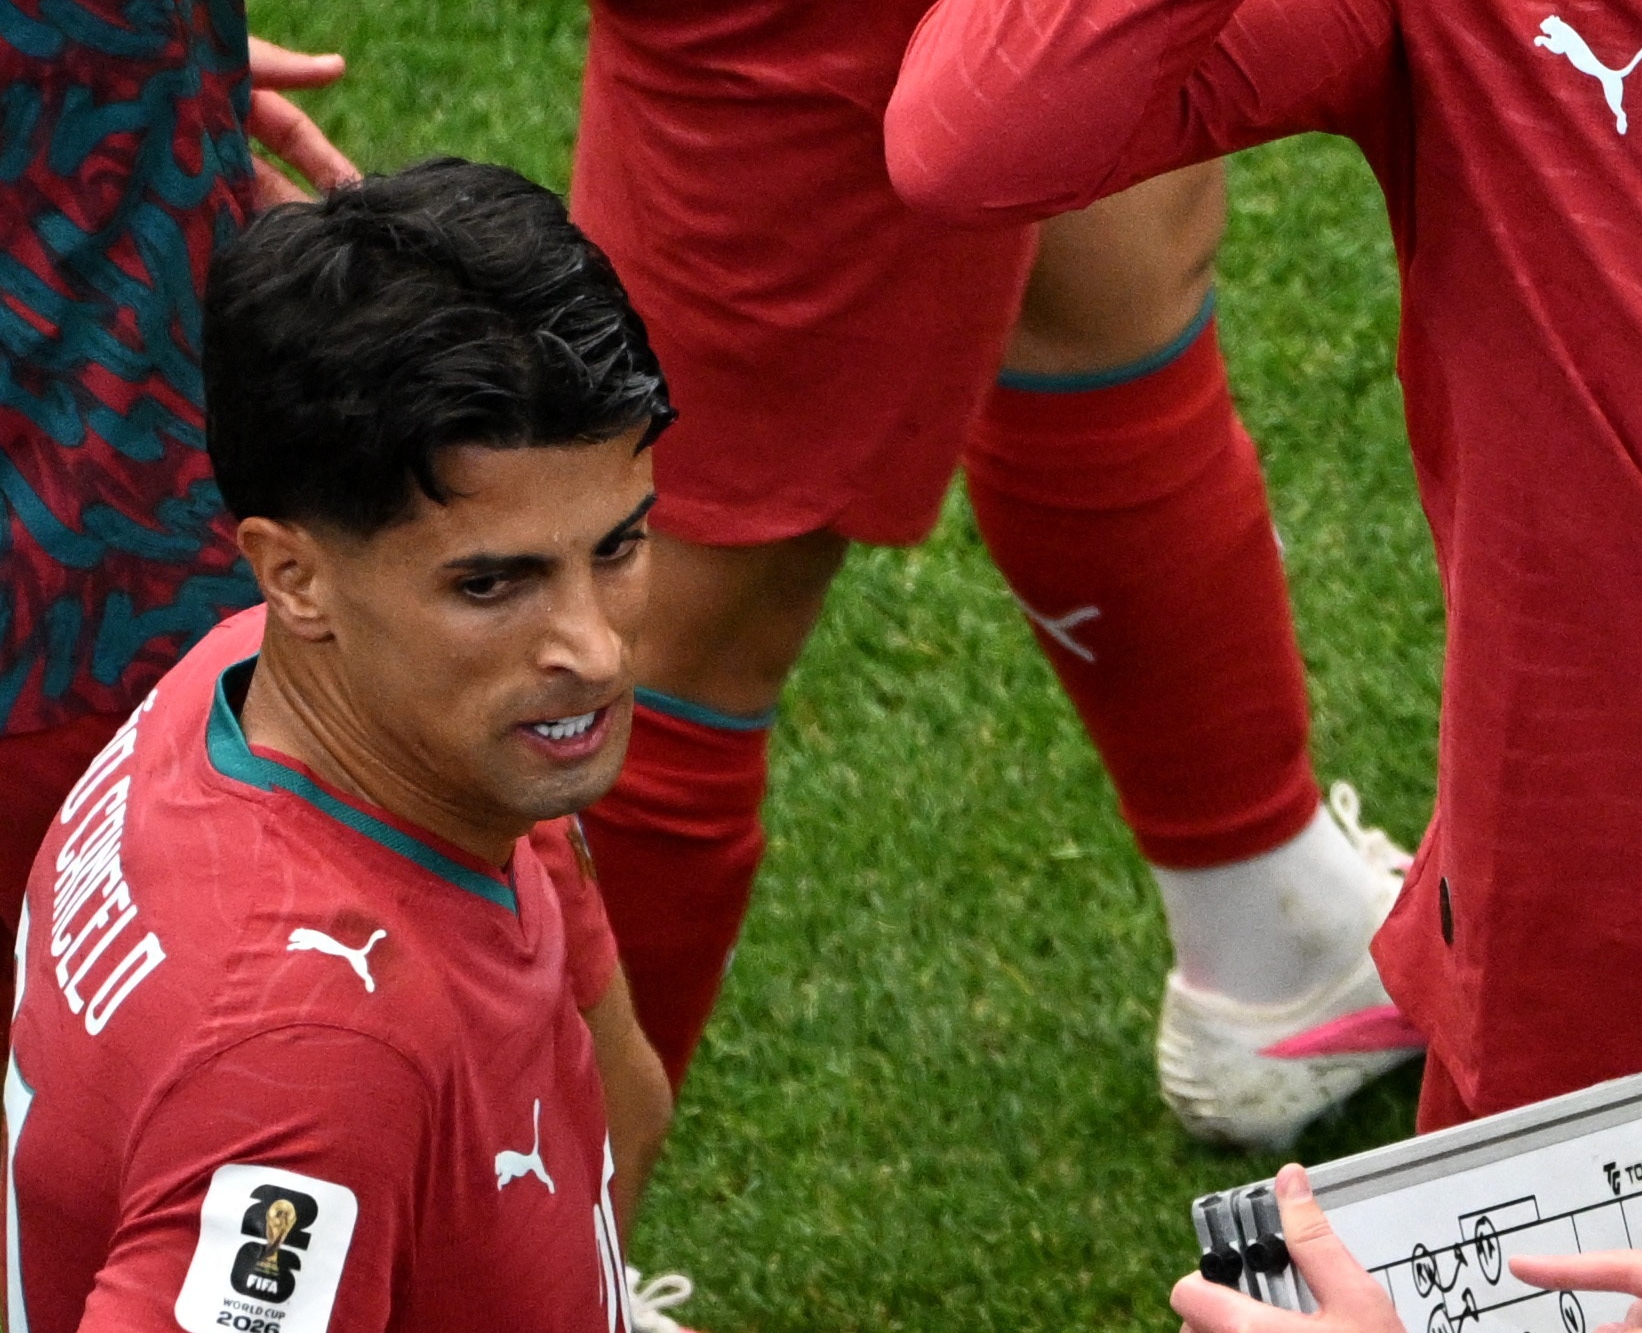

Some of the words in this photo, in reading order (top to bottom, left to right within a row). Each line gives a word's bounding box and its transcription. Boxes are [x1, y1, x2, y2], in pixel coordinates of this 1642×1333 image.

[246, 1273, 279, 1295] FIFA
[222, 1297, 264, 1317] WORLD
[264, 1307, 287, 1320] CUP
